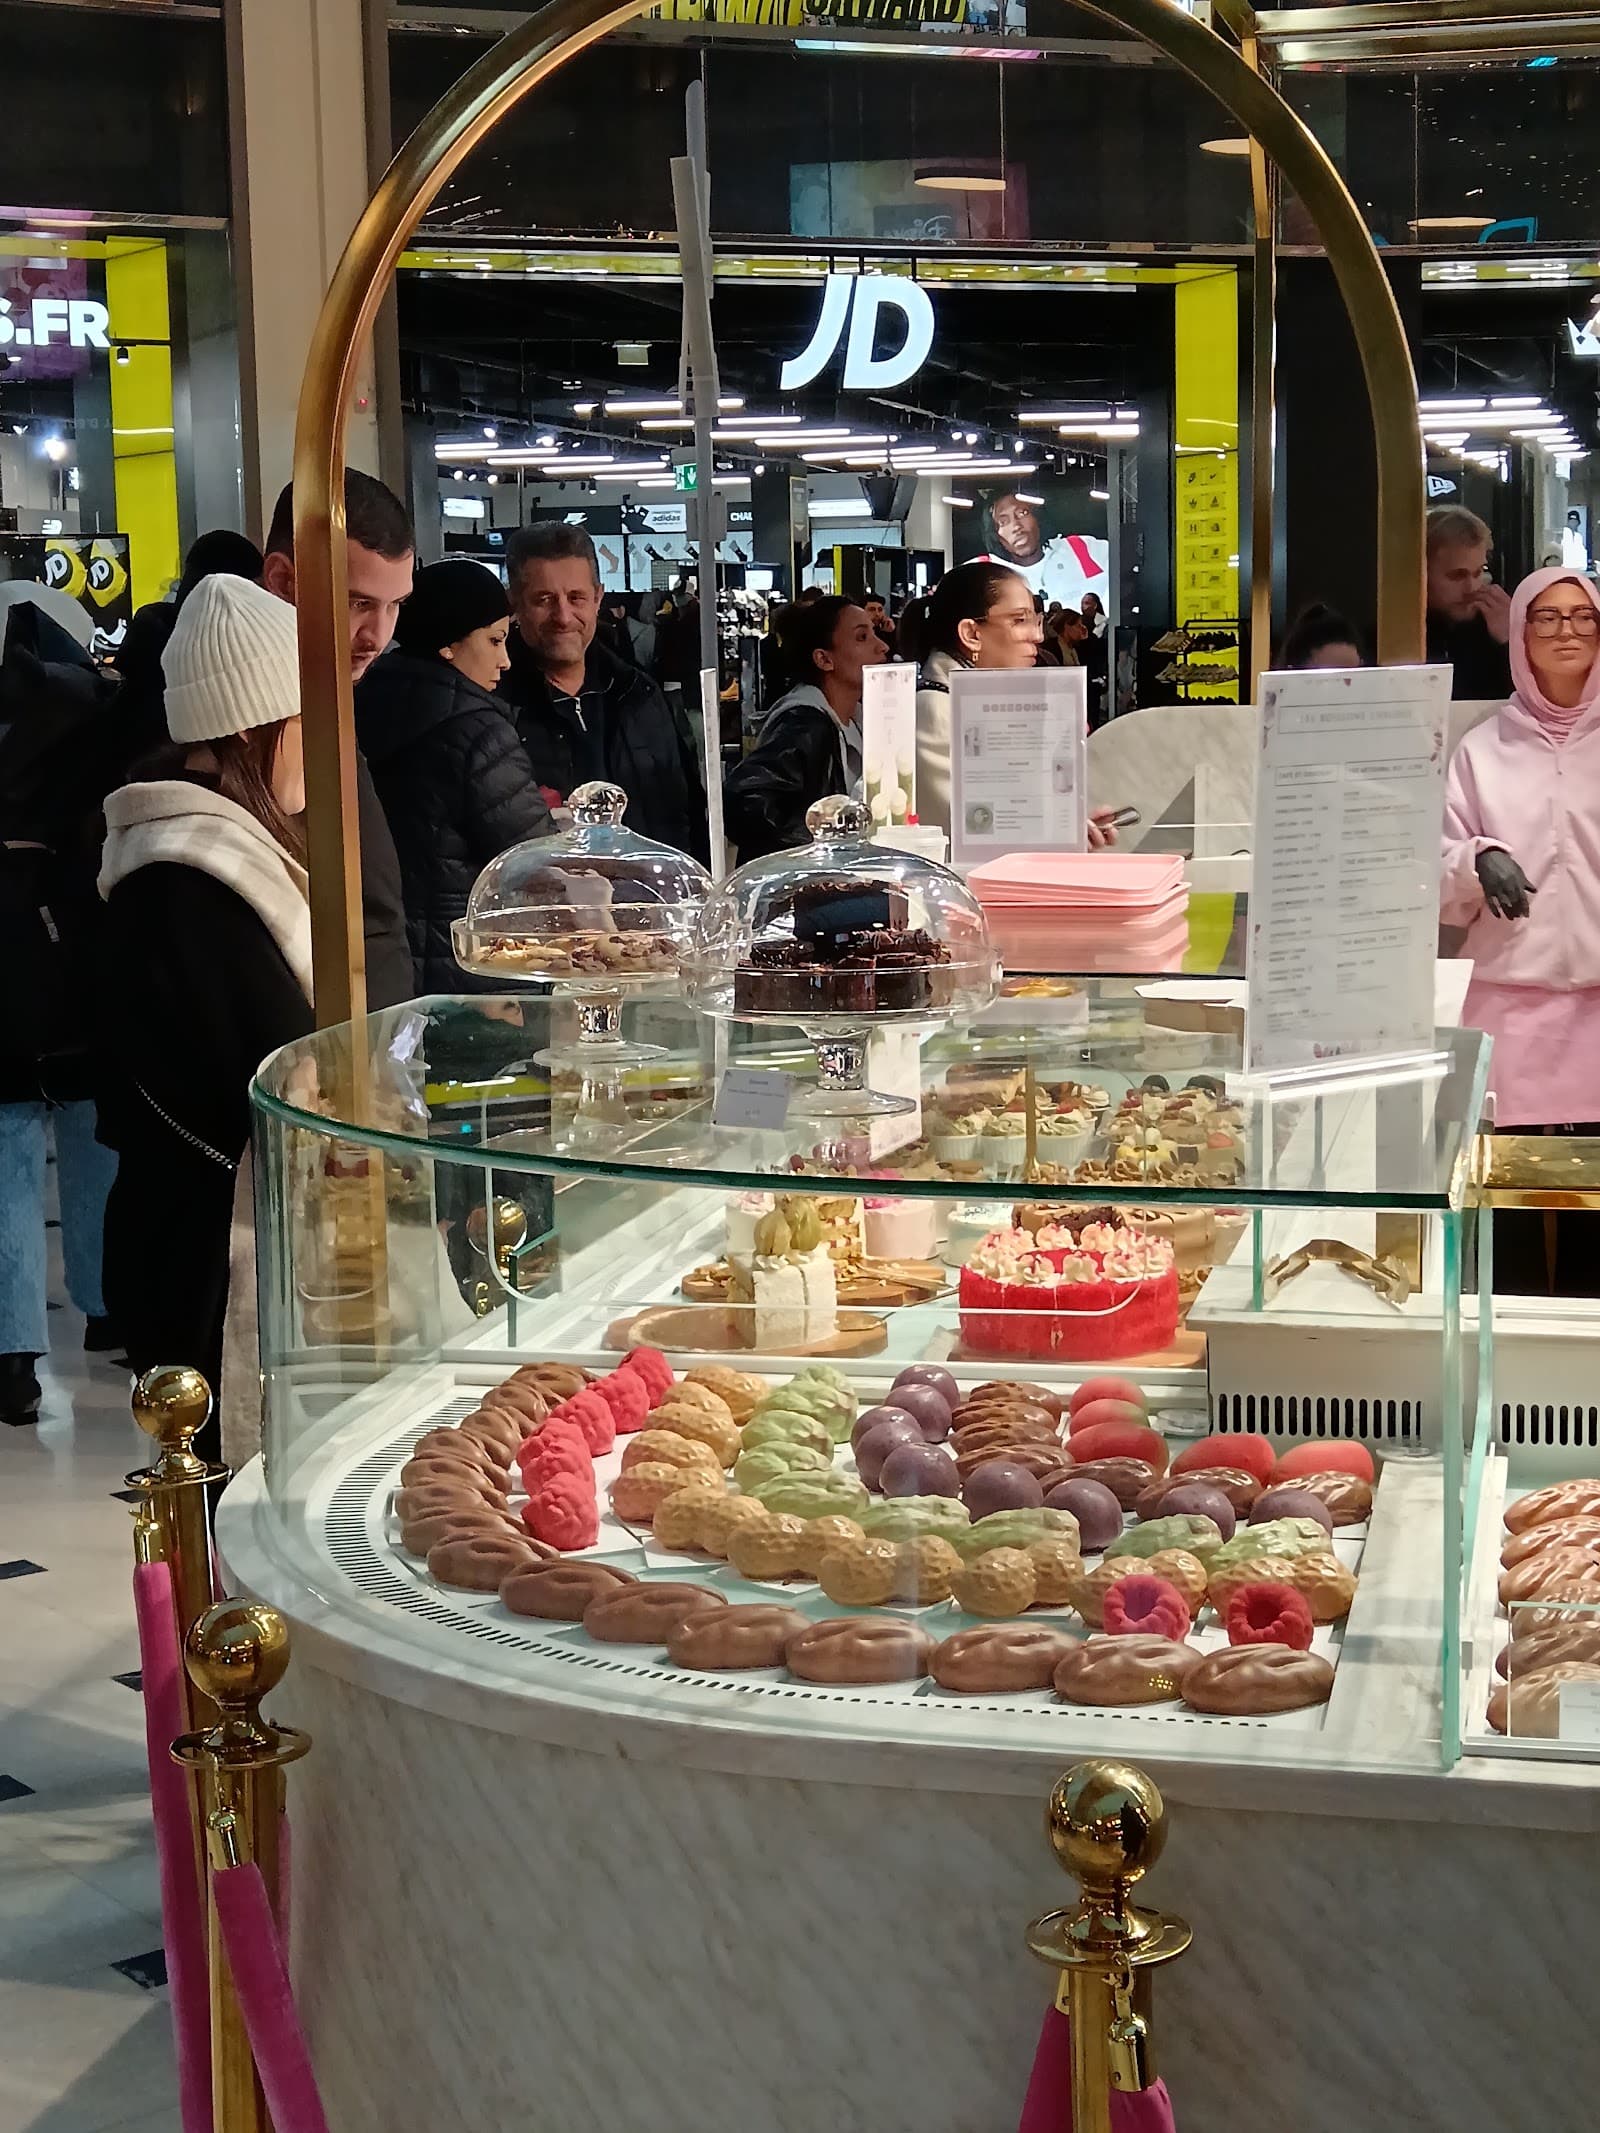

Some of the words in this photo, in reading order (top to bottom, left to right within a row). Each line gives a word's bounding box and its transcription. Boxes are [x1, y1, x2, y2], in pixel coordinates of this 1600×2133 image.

[779, 274, 935, 391] JD
[652, 513, 681, 522] adidas
[90, 559, 110, 588] JD
